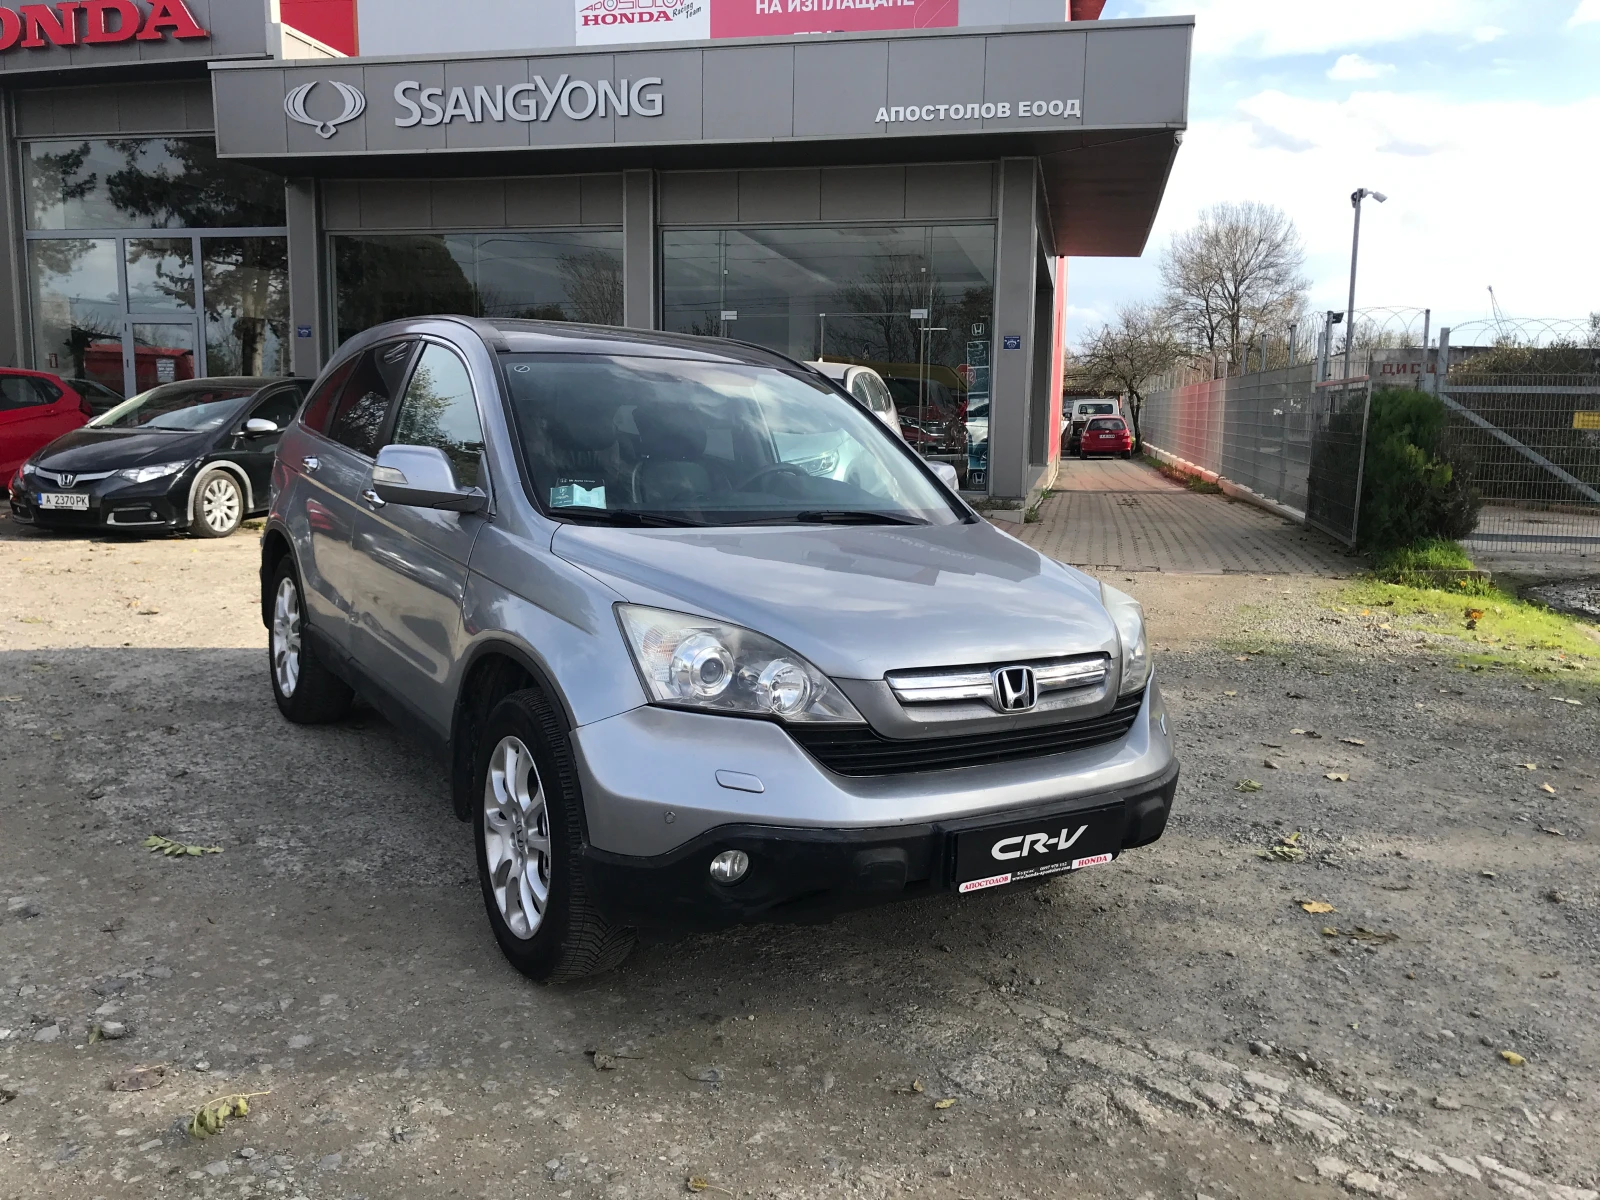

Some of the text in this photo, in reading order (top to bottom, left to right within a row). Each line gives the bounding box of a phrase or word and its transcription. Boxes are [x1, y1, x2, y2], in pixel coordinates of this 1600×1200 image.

[672, 2, 693, 17] Racing
[685, 6, 701, 19] Team
[755, 0, 782, 14] НА
[582, 11, 673, 26] HONDA
[875, 99, 1081, 123] АПОСТОЛОВ ЕООД
[991, 824, 1089, 860] CR-V
[1077, 855, 1108, 867] HONDA
